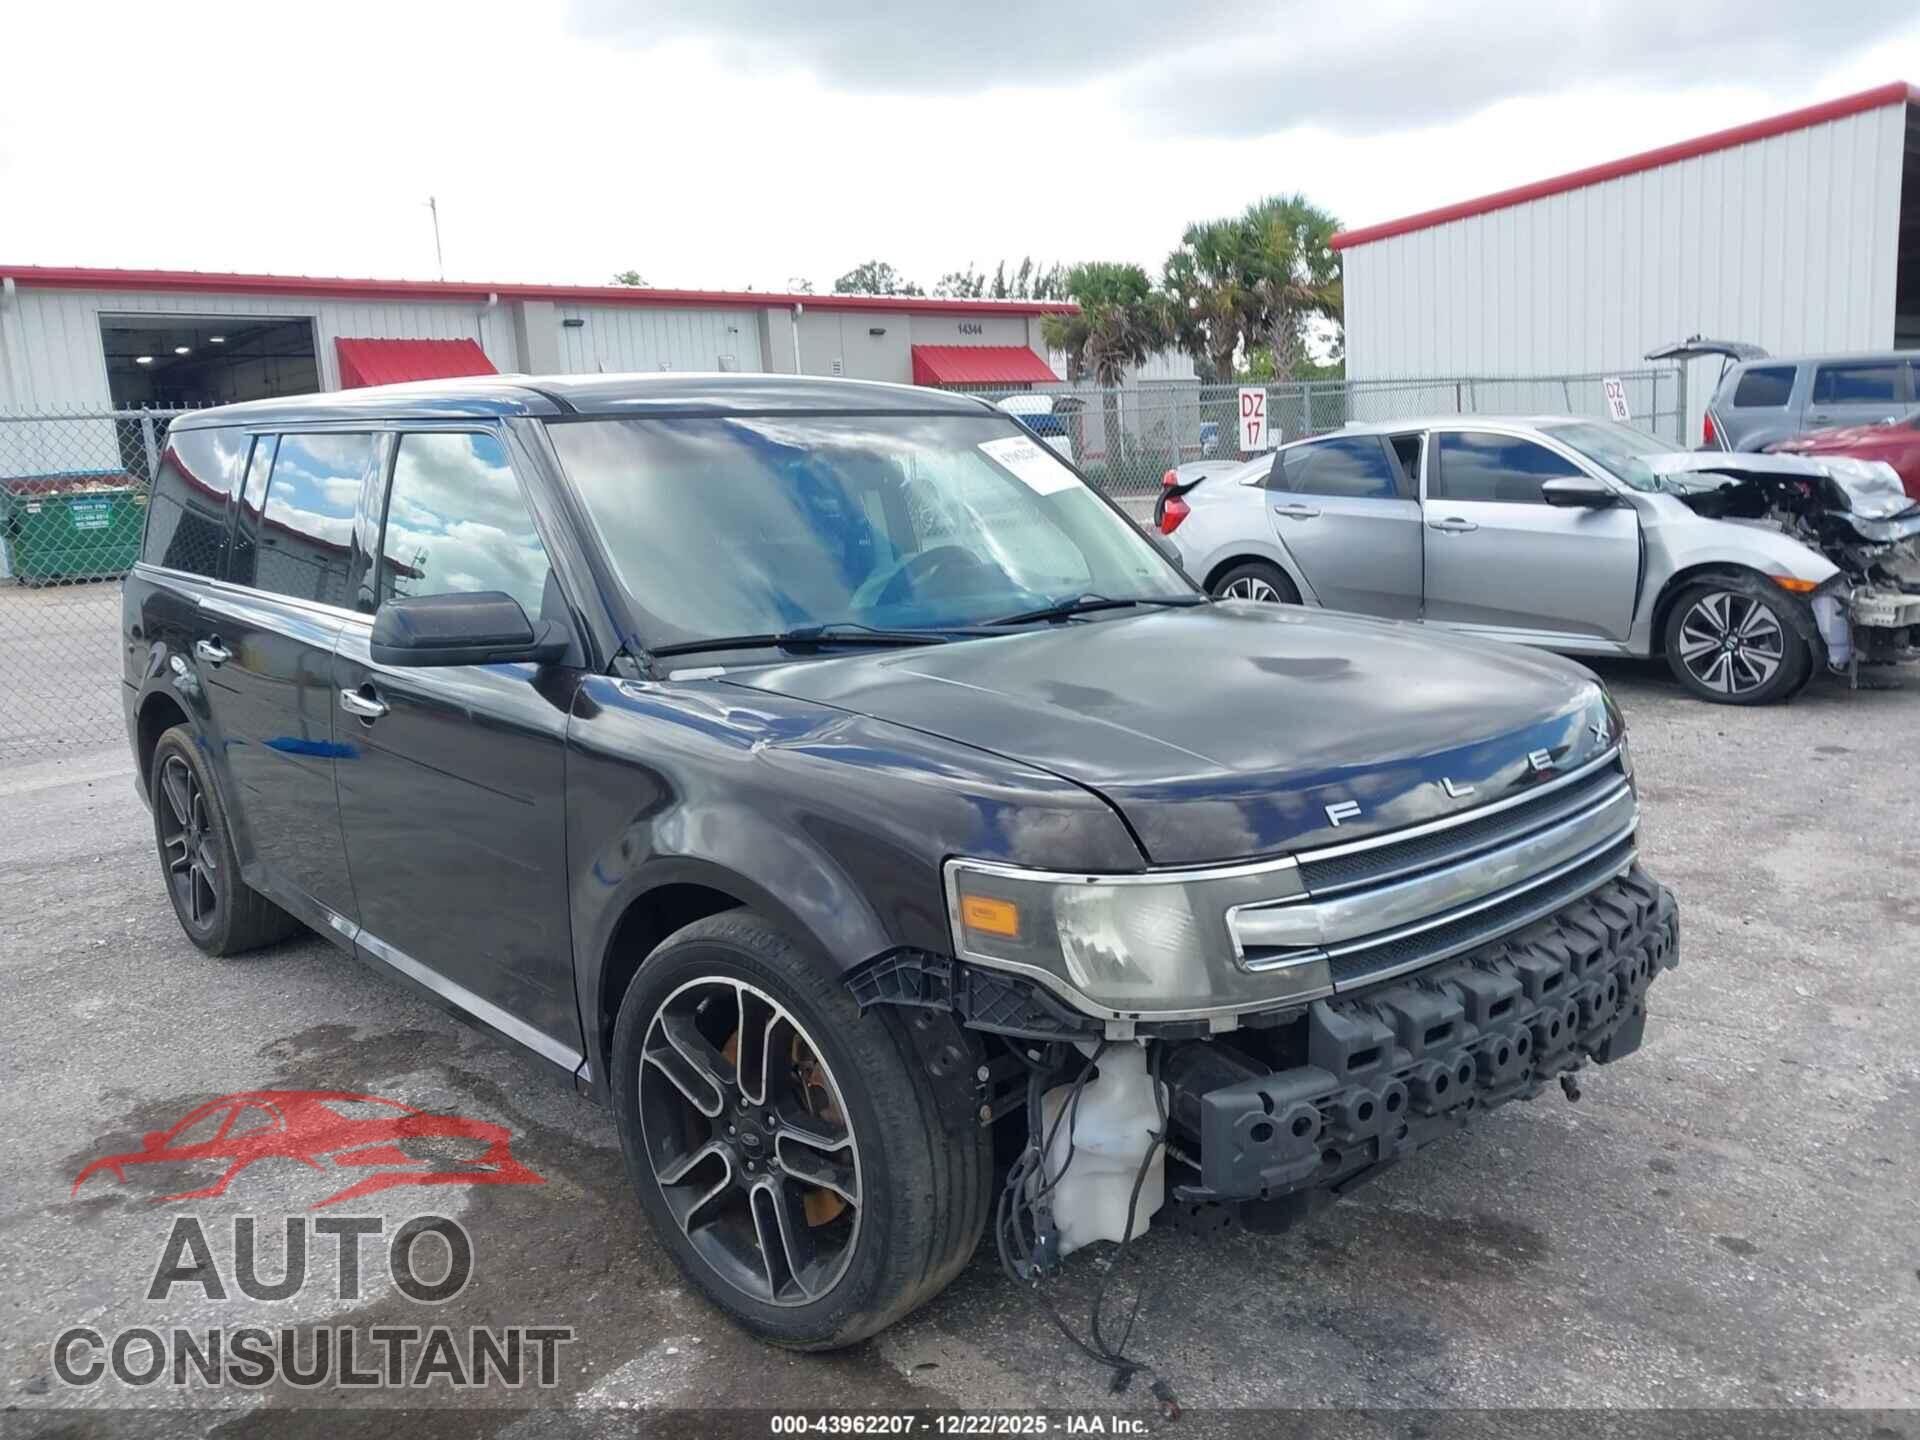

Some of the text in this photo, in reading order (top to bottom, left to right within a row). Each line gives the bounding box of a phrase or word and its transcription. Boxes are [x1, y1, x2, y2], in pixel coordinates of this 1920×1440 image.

[957, 321, 983, 336] 14344
[1606, 382, 1623, 399] DZ
[1242, 394, 1264, 417] DZ
[1614, 401, 1626, 417] 18
[1248, 422, 1260, 445] 17
[1324, 722, 1610, 827] FLEX
